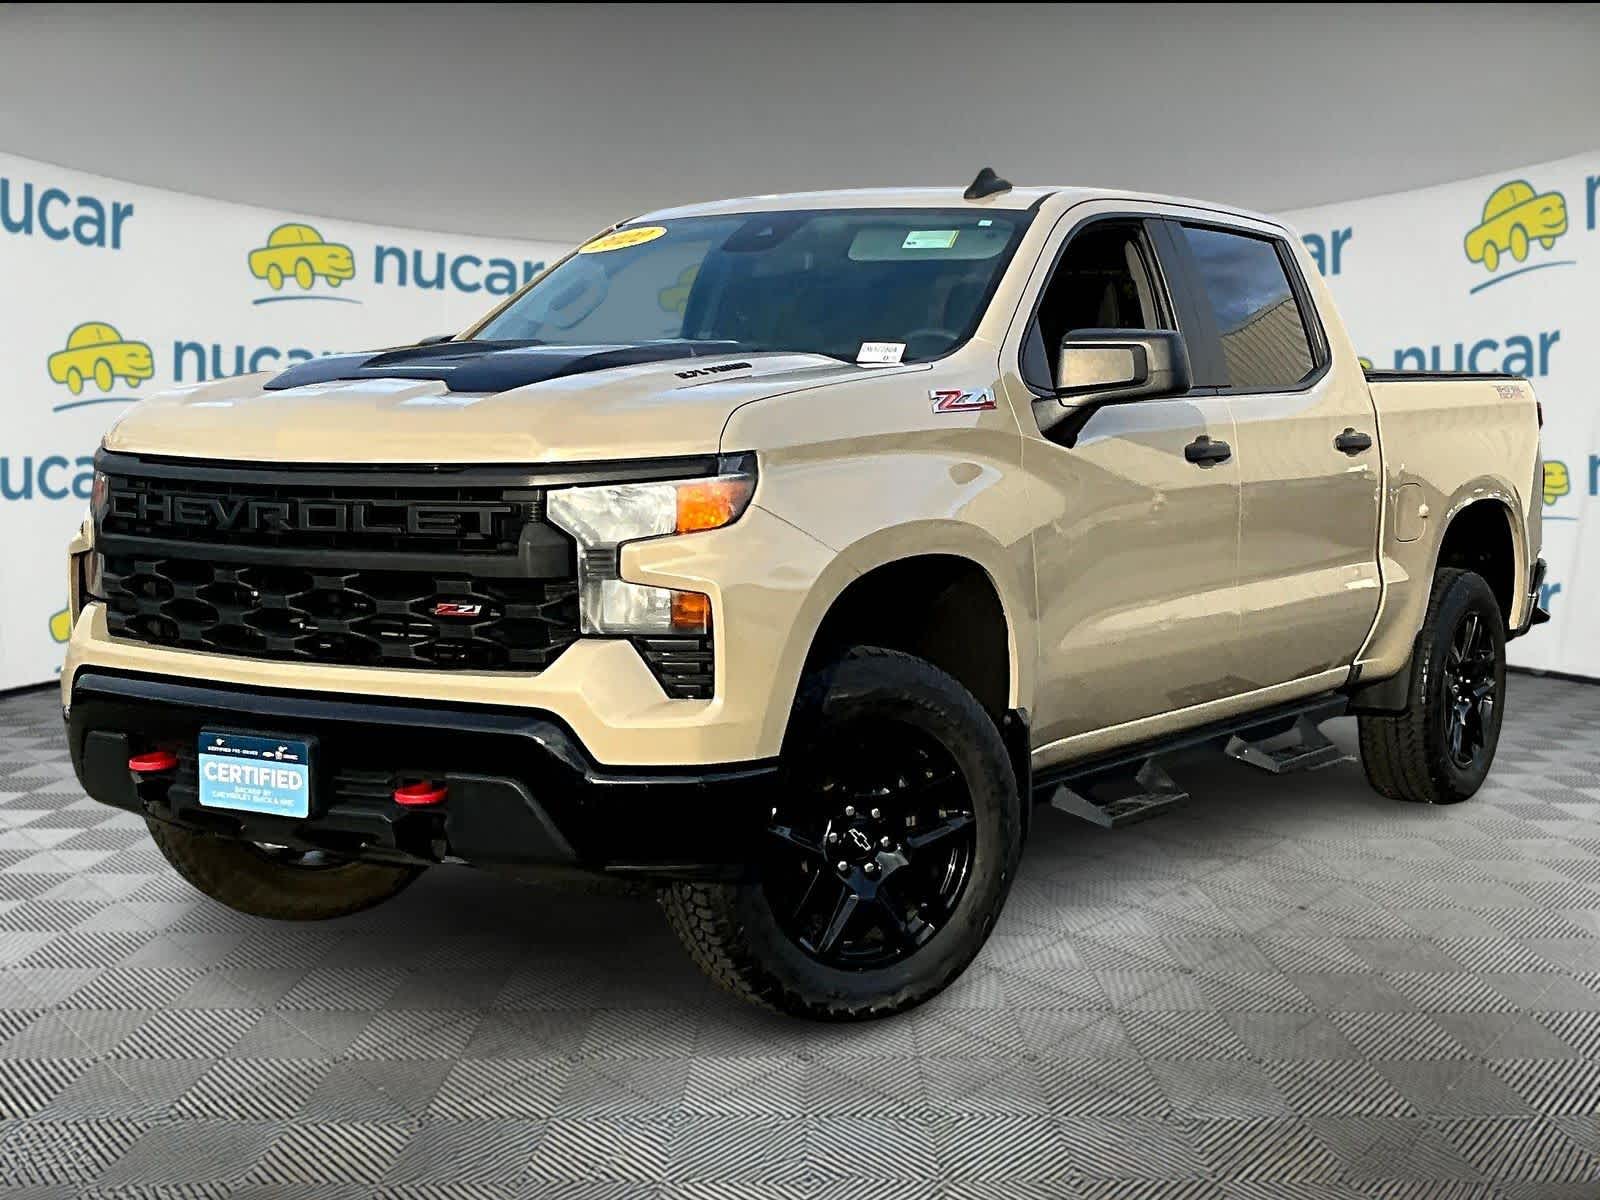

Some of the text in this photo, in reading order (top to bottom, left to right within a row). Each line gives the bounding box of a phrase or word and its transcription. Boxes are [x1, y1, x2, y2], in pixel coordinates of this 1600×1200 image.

[374, 245, 545, 295] nucar
[110, 491, 511, 536] CHEVROLET
[204, 761, 303, 791] CERTIFIED
